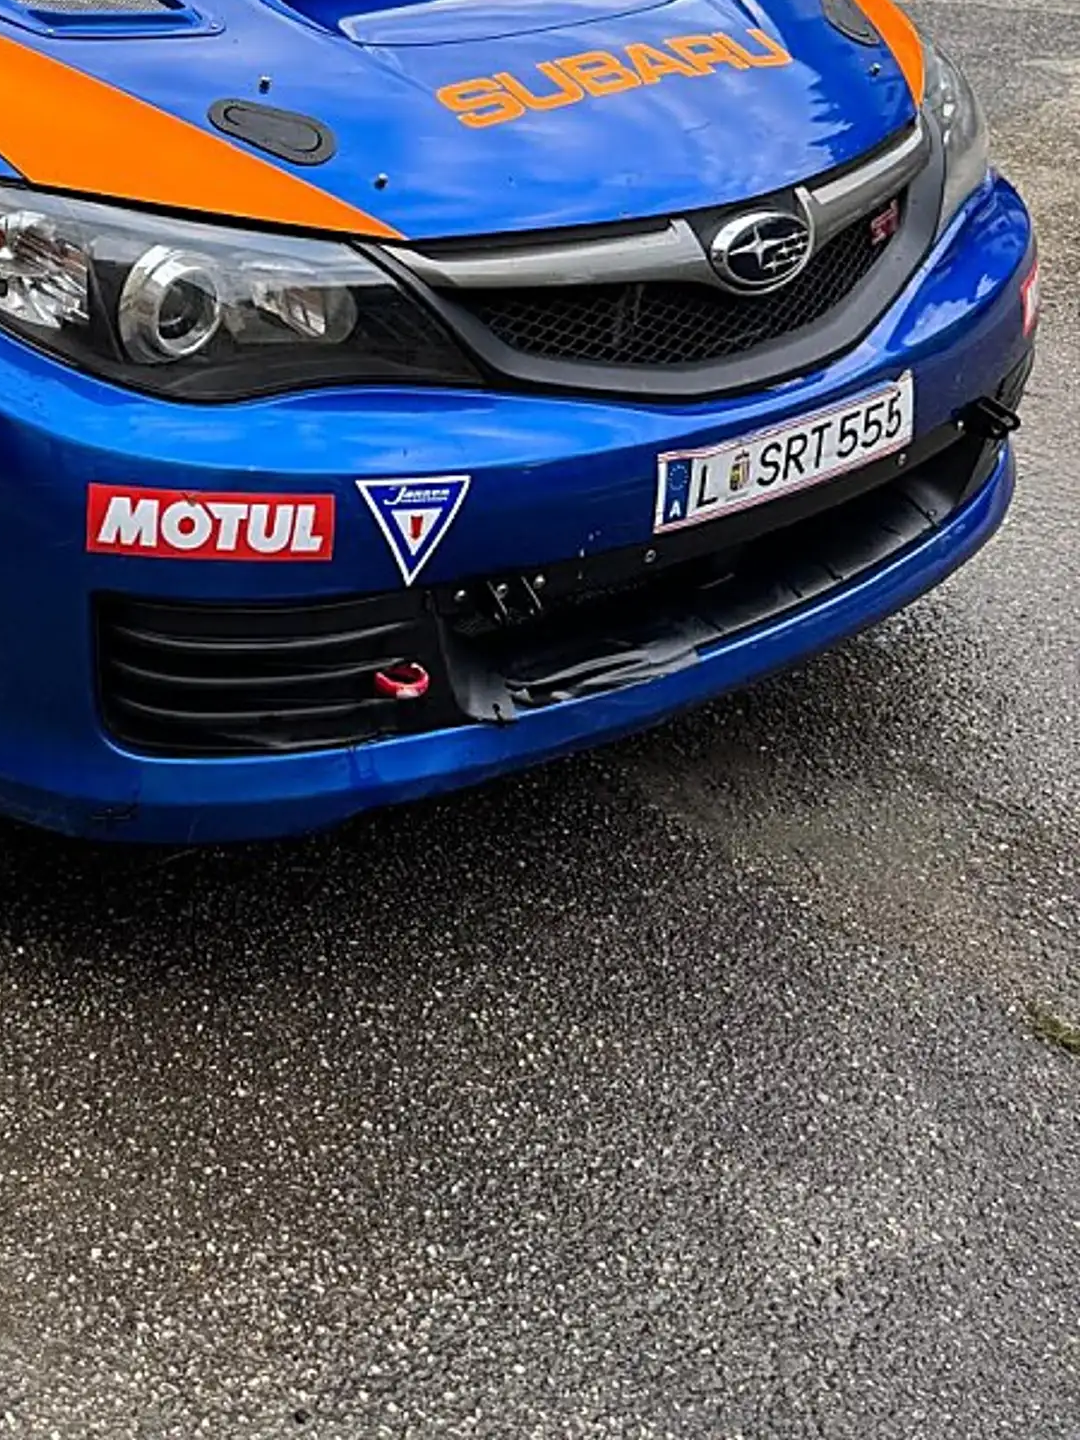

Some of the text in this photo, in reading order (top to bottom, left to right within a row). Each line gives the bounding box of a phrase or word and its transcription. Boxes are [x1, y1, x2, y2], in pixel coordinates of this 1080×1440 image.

[435, 27, 793, 128] SUBARU
[696, 391, 902, 508] L SRT 555
[97, 496, 323, 553] MOTUL
[669, 500, 681, 518] A
